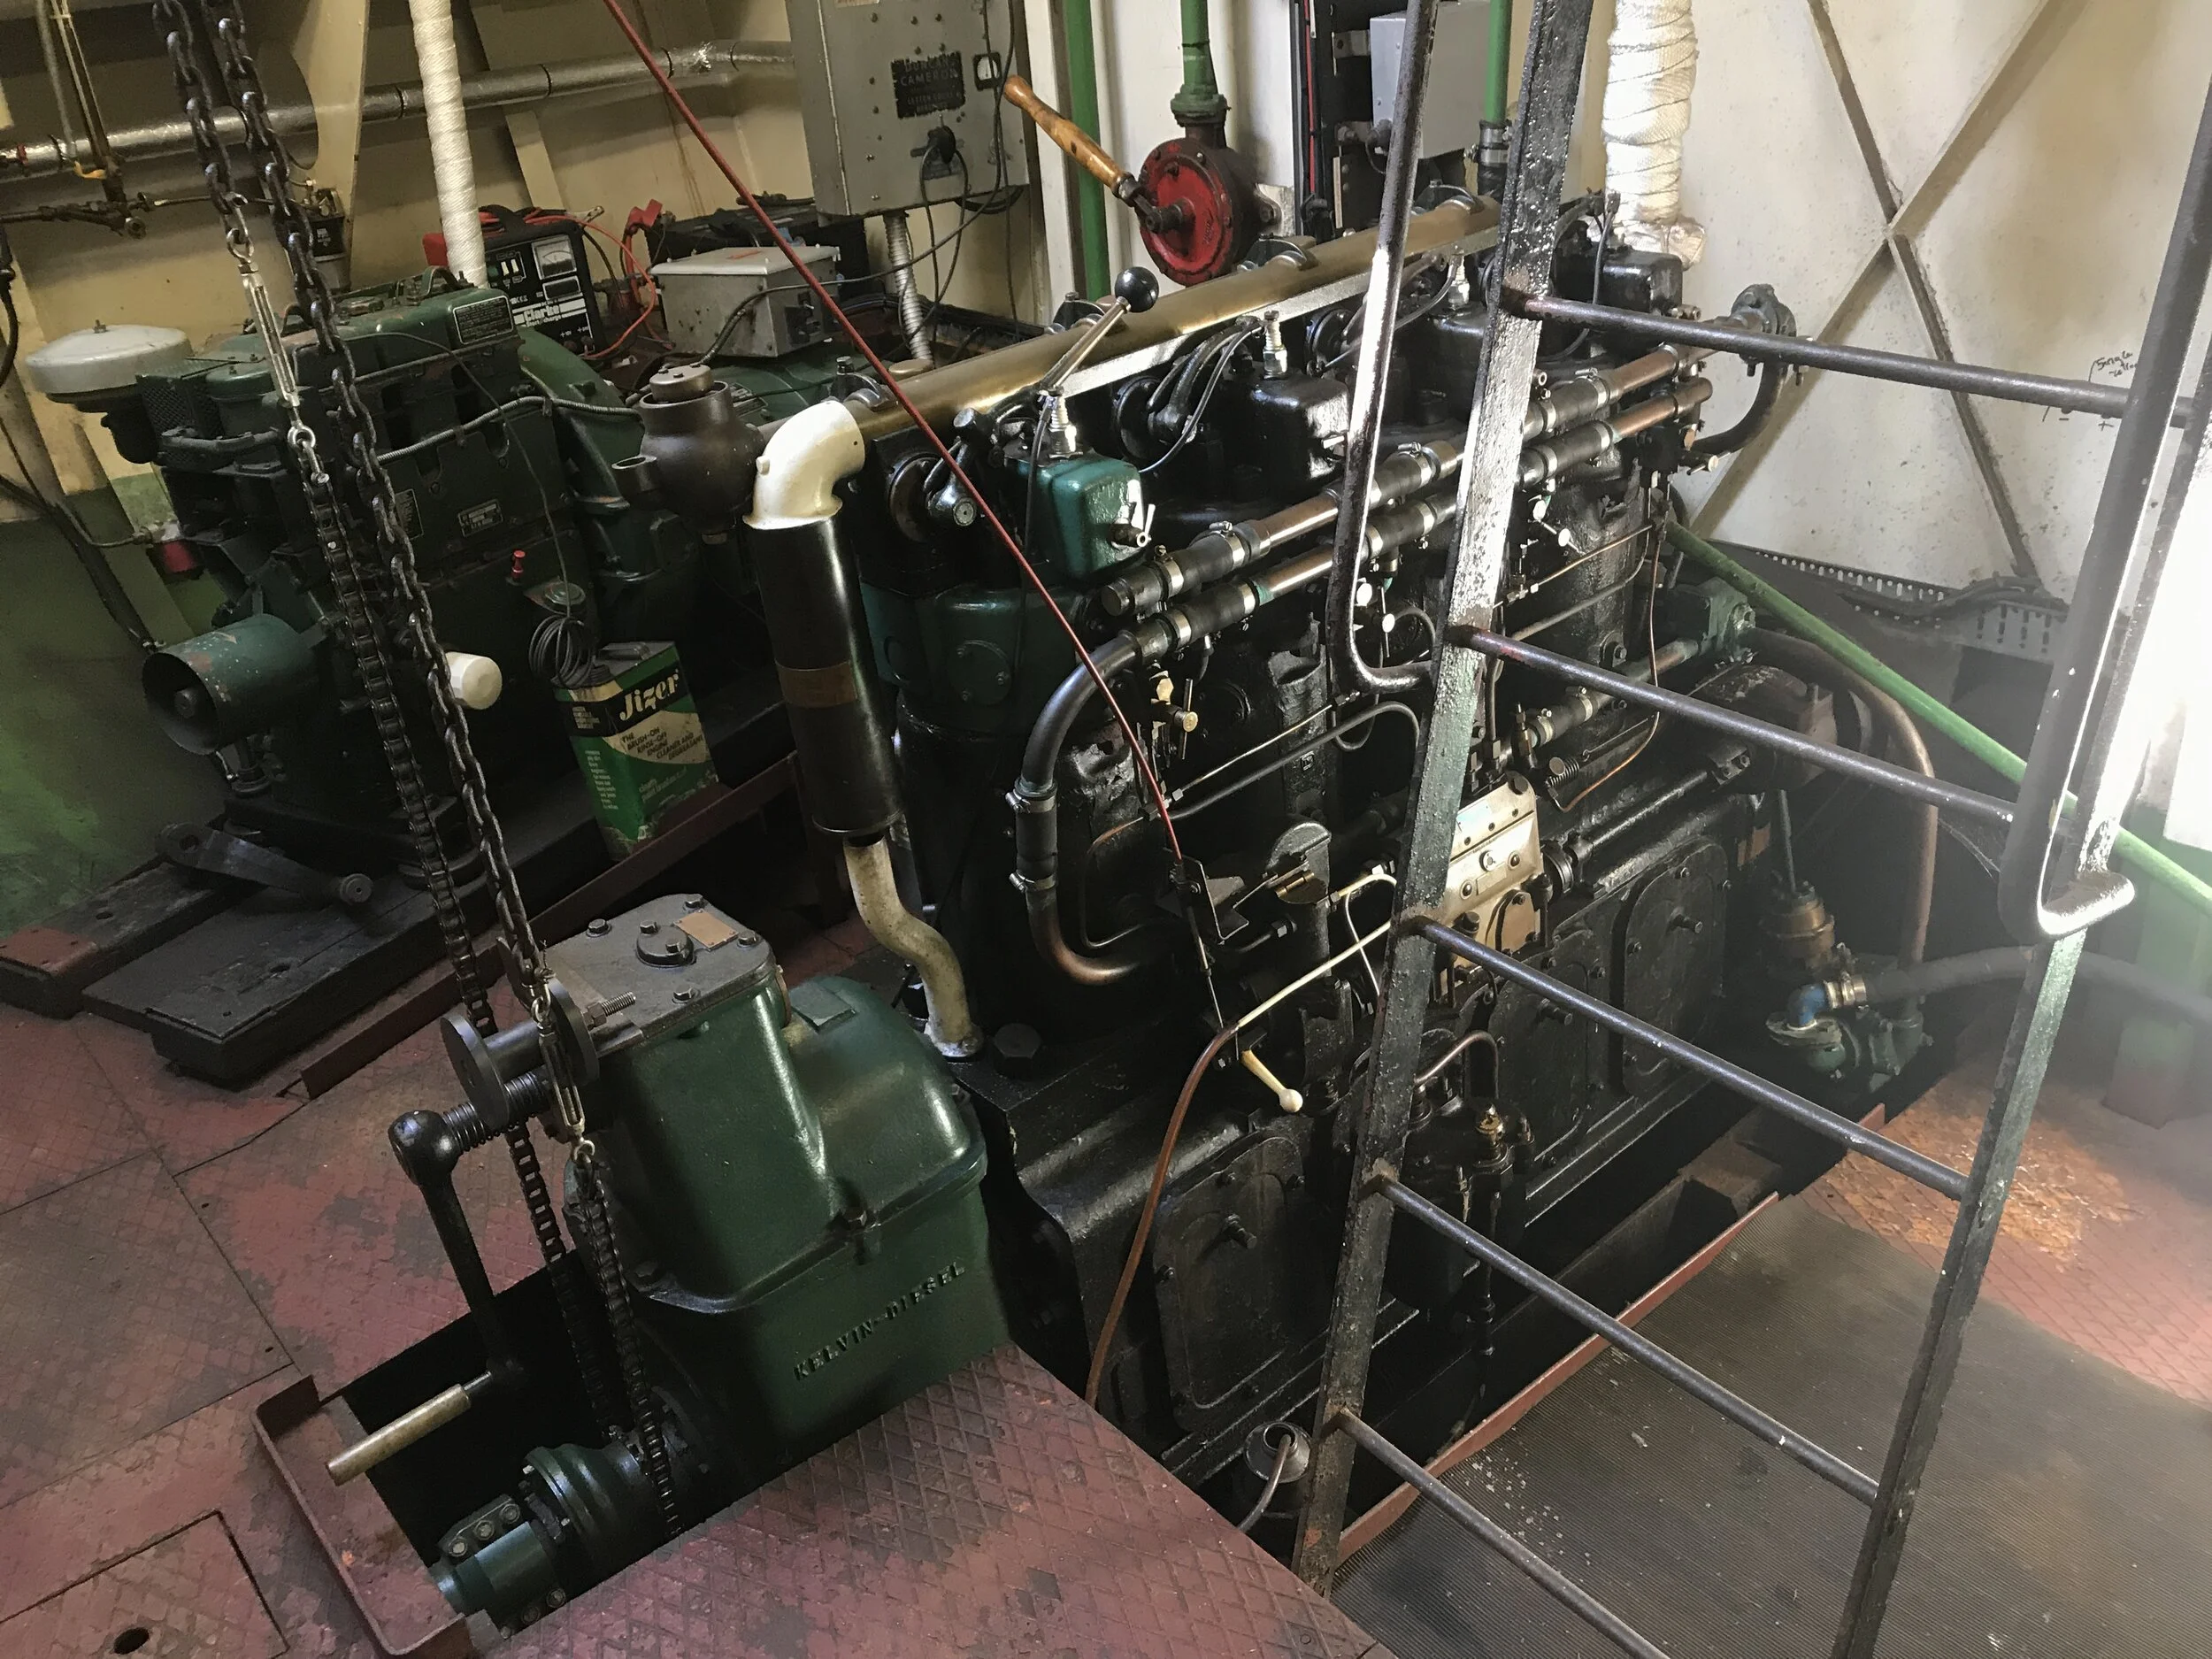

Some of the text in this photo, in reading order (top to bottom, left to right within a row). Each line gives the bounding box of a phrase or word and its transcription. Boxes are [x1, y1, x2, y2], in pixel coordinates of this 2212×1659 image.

[901, 68, 958, 86] CAMERON
[524, 304, 560, 321] Clarke
[619, 672, 679, 721] Jizer
[622, 732, 634, 742] THE
[627, 726, 660, 750] BRUSH-ON
[637, 732, 667, 754] RINSE-OFF
[657, 732, 695, 759] CLEANER AND
